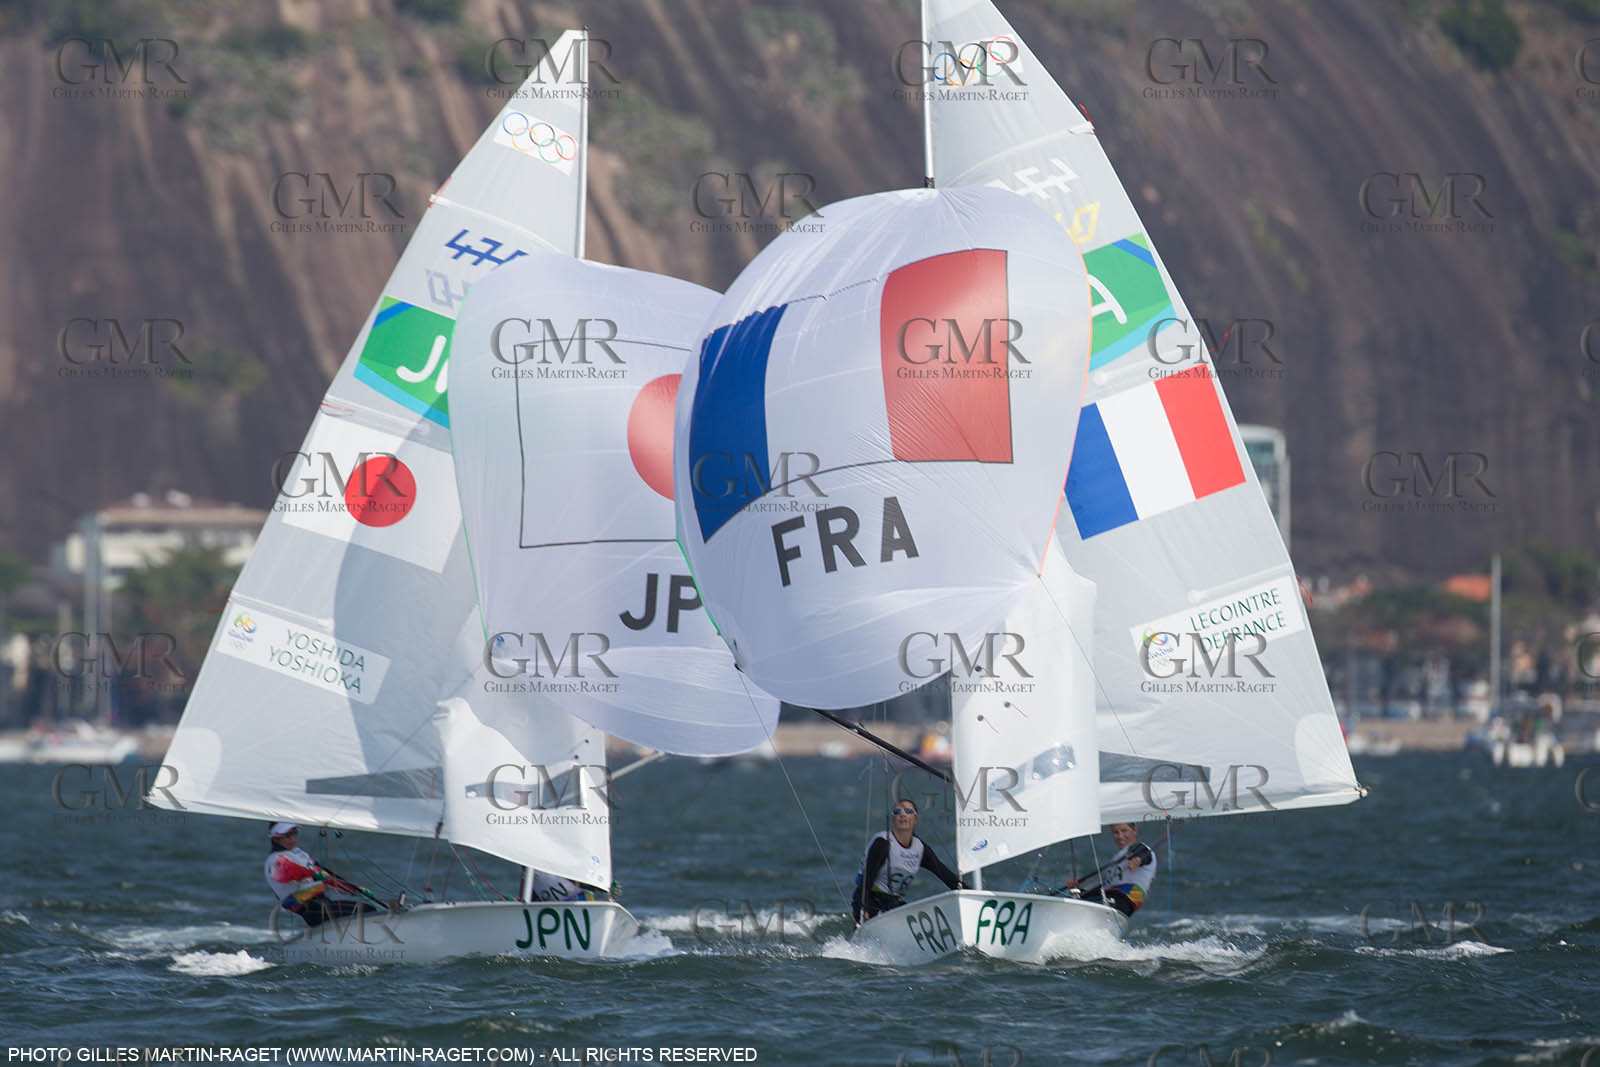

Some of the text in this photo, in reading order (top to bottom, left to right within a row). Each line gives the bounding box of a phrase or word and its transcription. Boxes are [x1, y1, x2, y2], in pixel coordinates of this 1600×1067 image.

[445, 229, 529, 266] 47
[771, 496, 919, 587] FRA
[619, 573, 703, 633] JP
[1189, 588, 1282, 632] LECOINTRE
[287, 629, 366, 672] YOSHIDA
[1199, 611, 1287, 654] DEFRANCE
[269, 646, 362, 694] YOSHIOKA
[515, 907, 591, 950] JPN
[906, 905, 957, 953] FRA
[975, 900, 1033, 947] FRA
